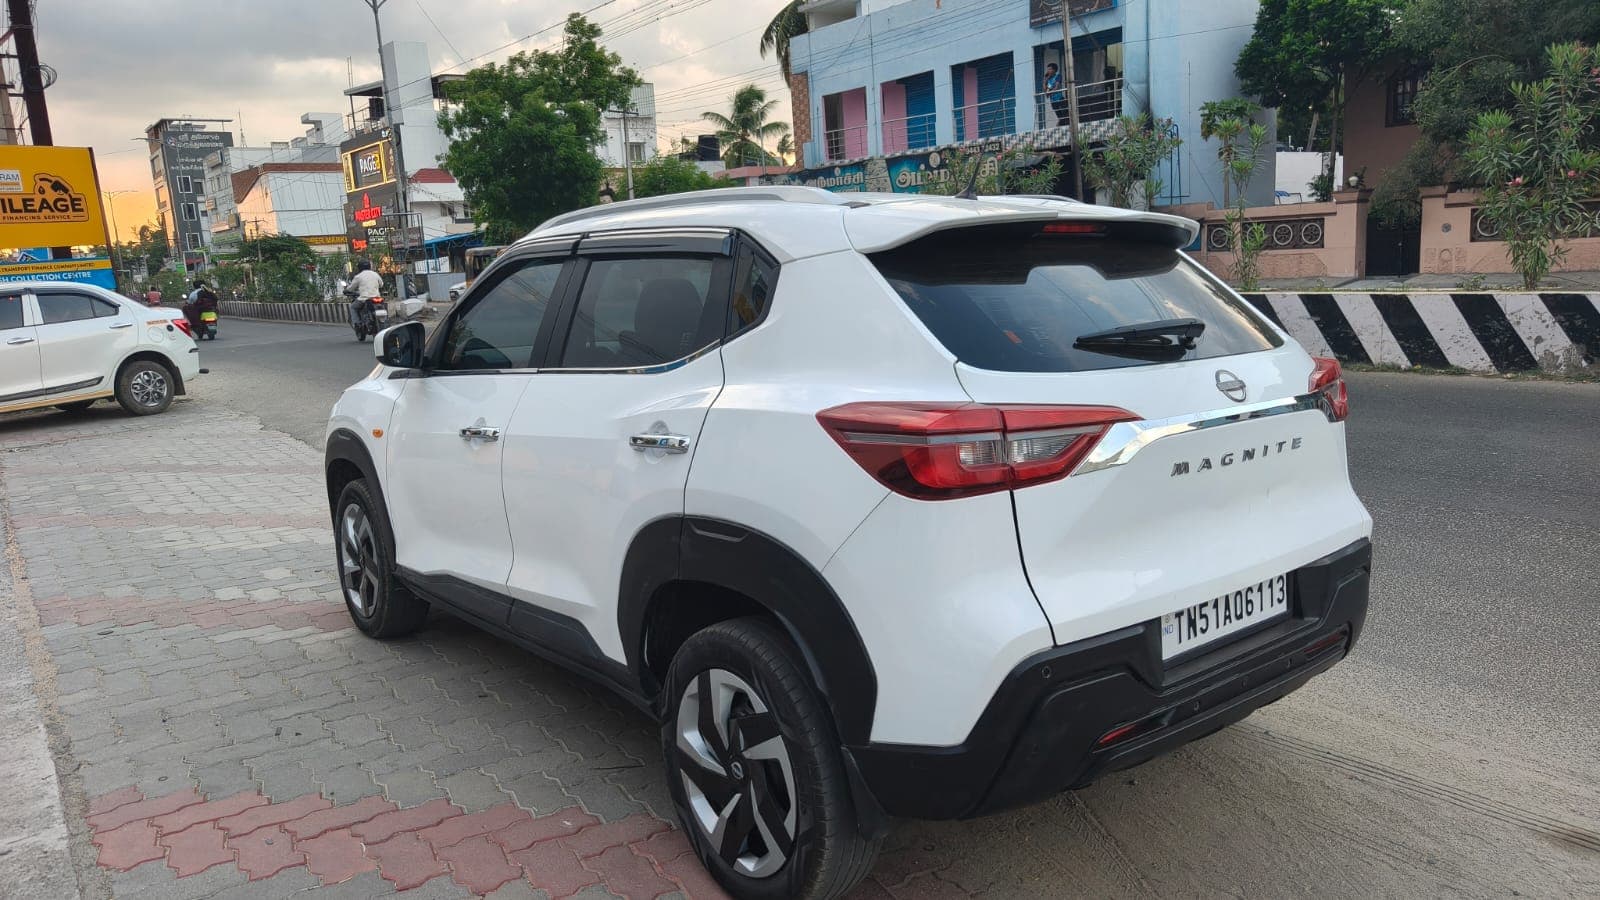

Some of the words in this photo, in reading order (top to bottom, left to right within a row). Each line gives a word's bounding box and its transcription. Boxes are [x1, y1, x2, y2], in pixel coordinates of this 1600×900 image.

[10, 273, 61, 282] COLLECTION
[62, 271, 92, 279] CENTRE
[1170, 436, 1303, 477] MAGNITE
[1174, 575, 1286, 644] TN51AQ6113
